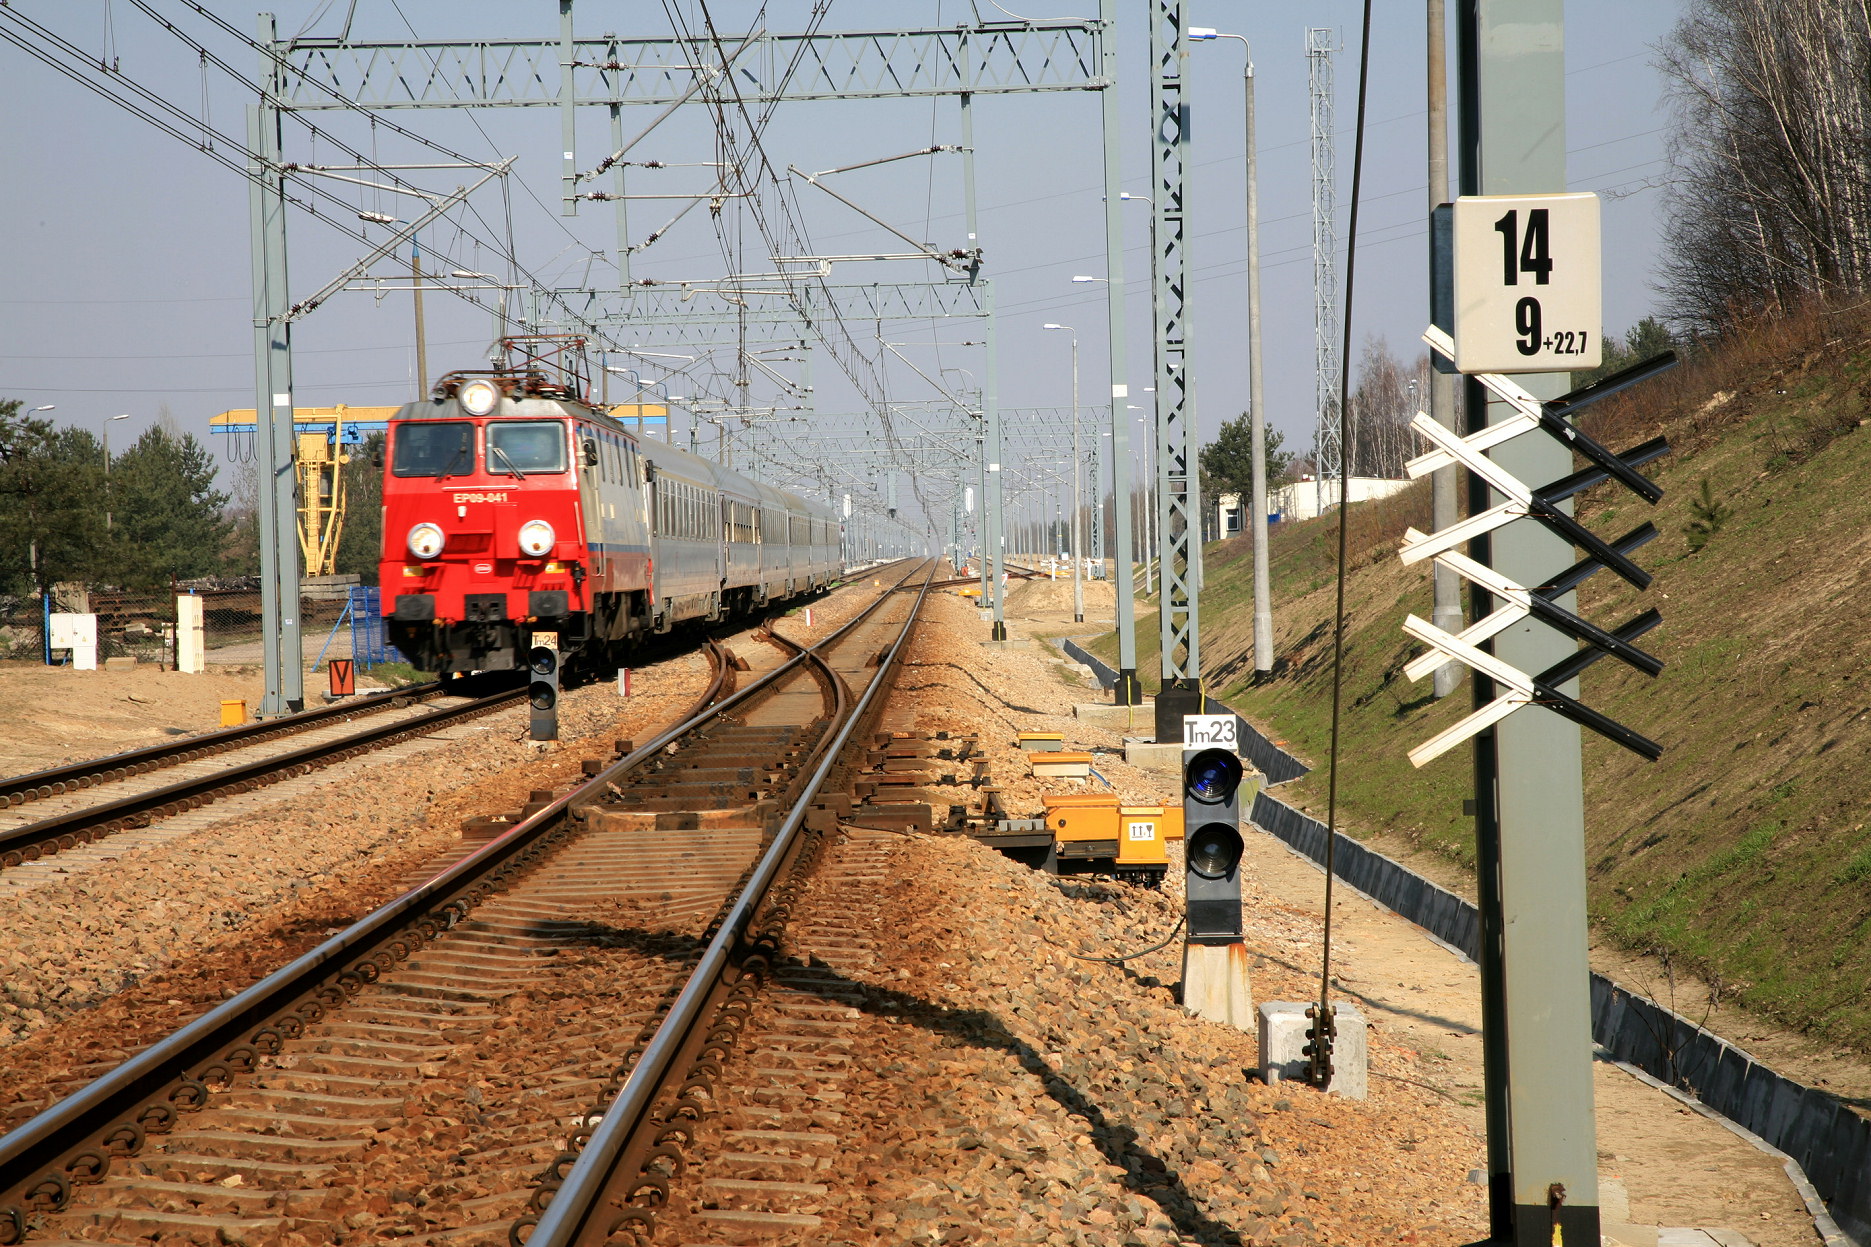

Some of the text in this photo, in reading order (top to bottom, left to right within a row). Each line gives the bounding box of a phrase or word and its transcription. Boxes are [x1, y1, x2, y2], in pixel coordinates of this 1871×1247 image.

[1494, 208, 1553, 286] 14
[453, 492, 508, 504] EP09-041
[532, 634, 557, 646] Tm24
[1184, 720, 1236, 743] Tm23
